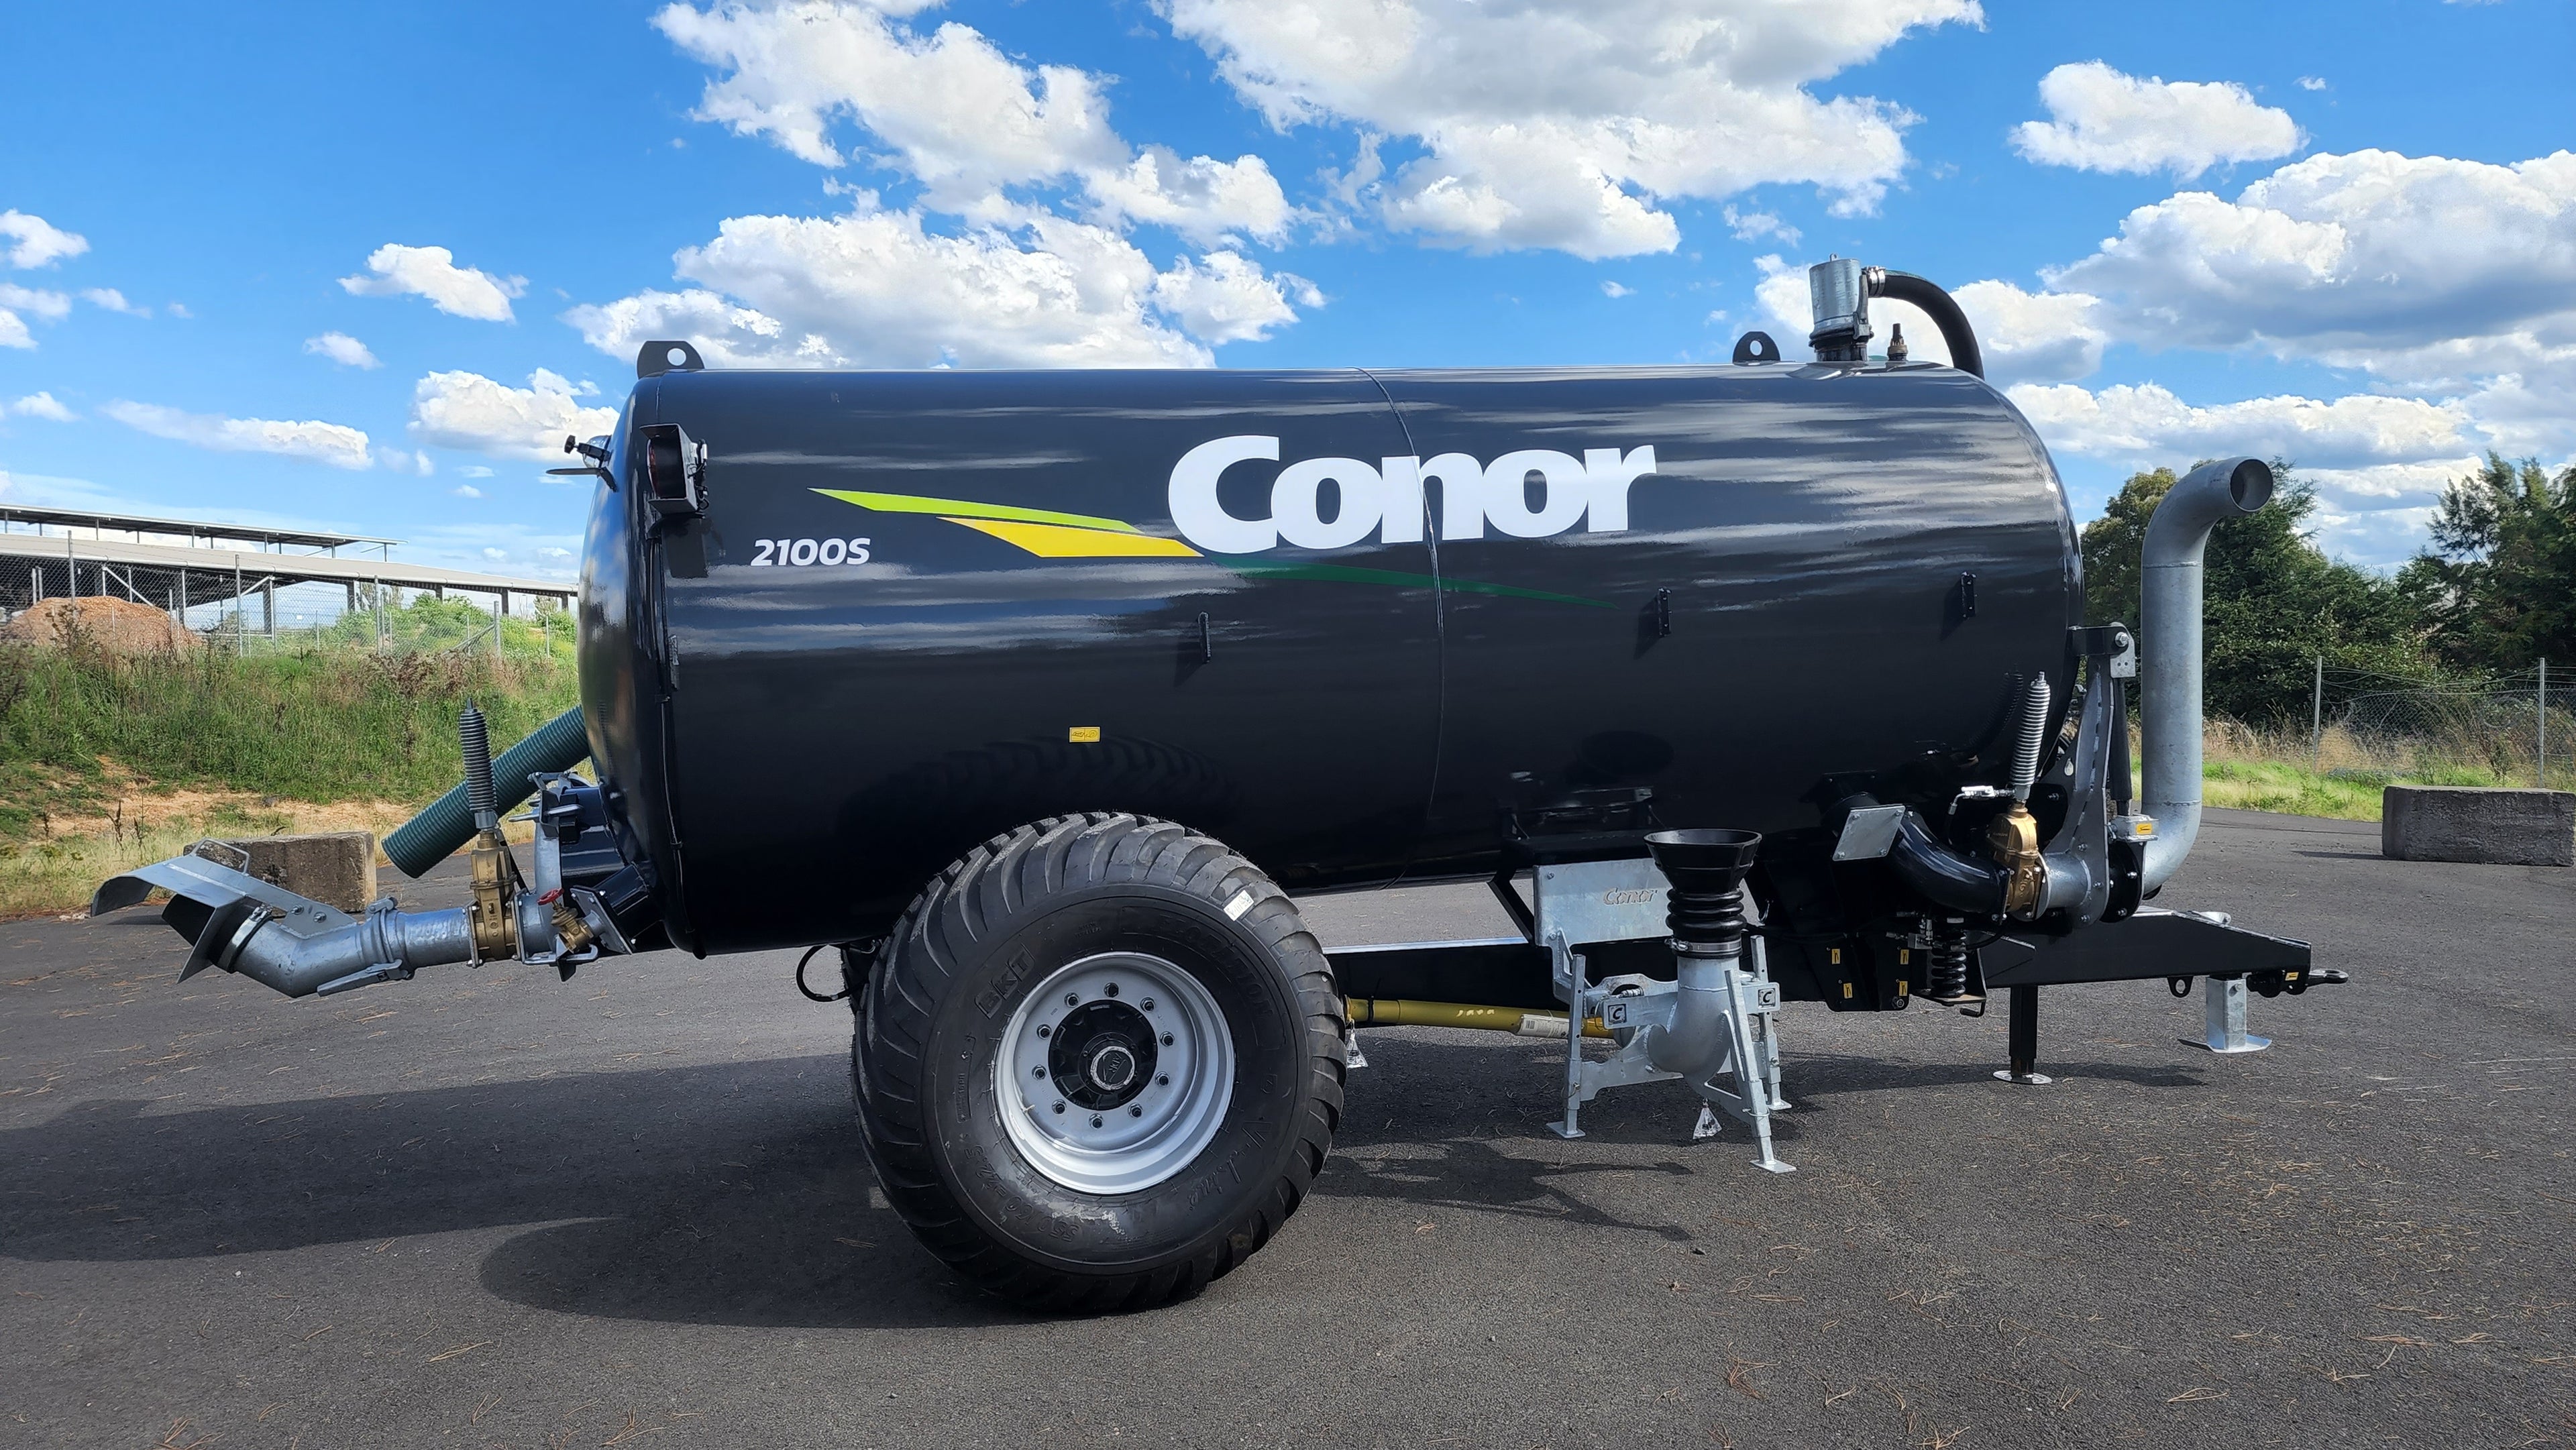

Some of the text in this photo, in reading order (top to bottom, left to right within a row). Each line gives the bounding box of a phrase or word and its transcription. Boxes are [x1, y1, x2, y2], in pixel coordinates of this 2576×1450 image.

[1169, 435, 1657, 554] Conor
[751, 537, 871, 566] 2100S
[1604, 888, 1658, 905] Conor
[976, 946, 1034, 1017] BKT
[1763, 991, 1772, 1003] C
[1613, 1007, 1624, 1020] C
